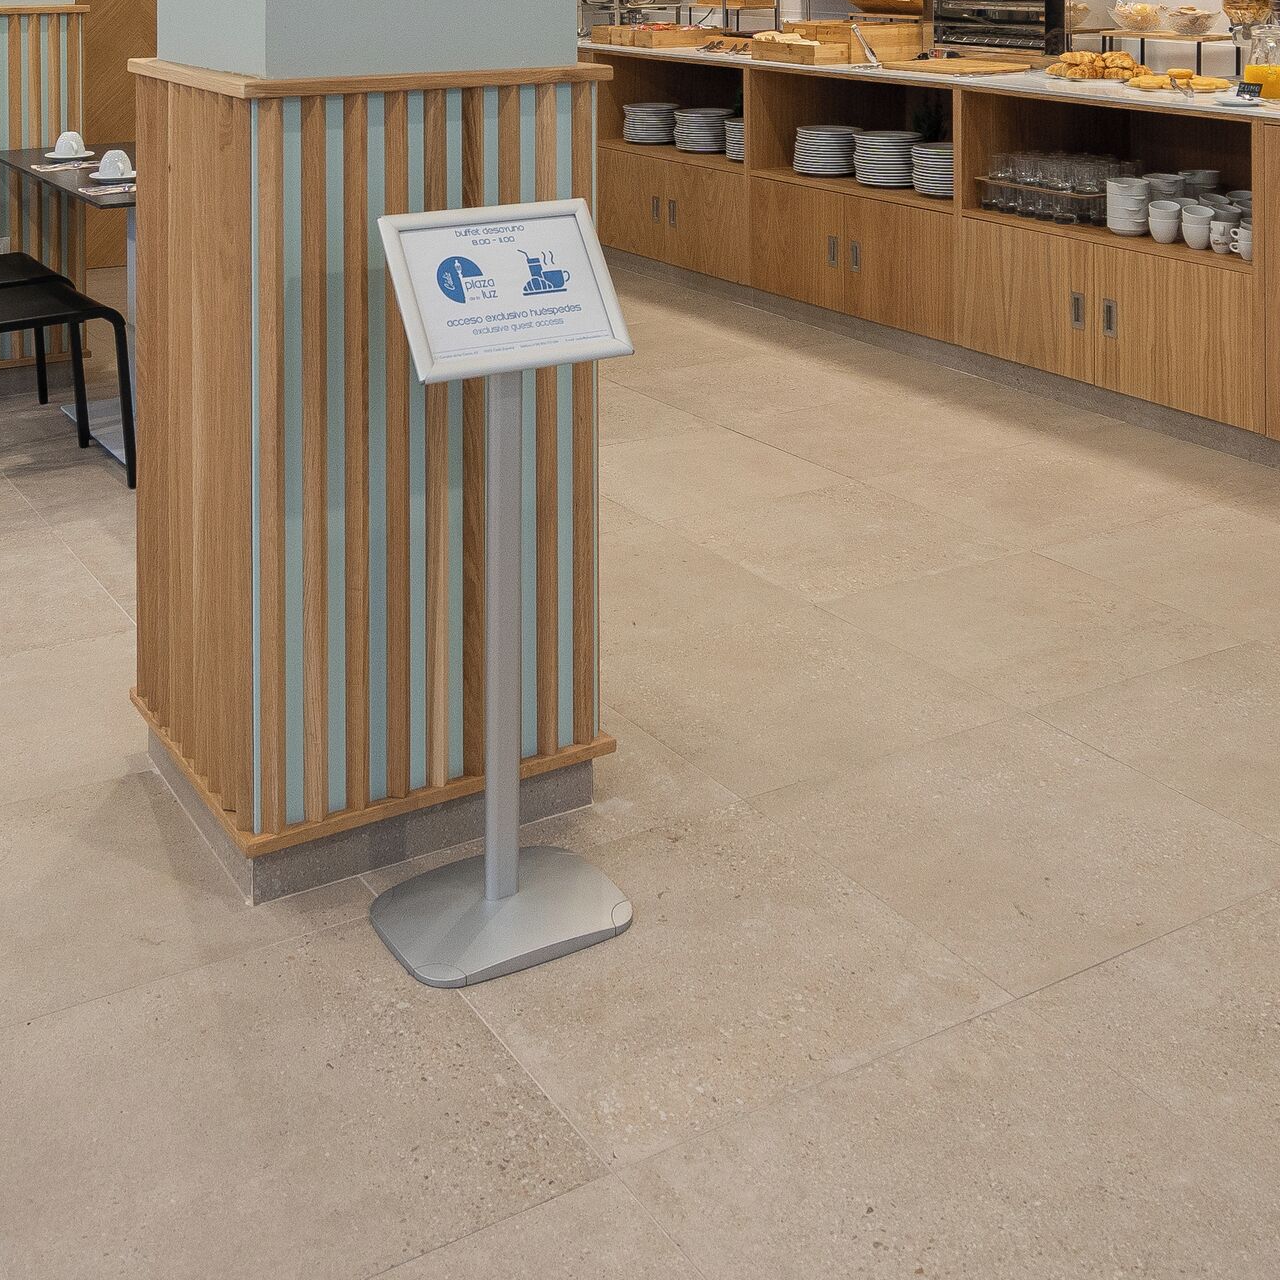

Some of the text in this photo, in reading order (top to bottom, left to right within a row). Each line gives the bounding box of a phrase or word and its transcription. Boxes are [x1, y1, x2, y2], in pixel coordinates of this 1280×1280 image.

[1239, 84, 1261, 92] ZUMO
[455, 224, 525, 238] buffet desayuno
[464, 278, 495, 292] plaza
[481, 289, 498, 300] luz
[446, 315, 483, 327] acceso
[485, 309, 528, 322] exclusivo
[472, 317, 565, 336] exclusive guest access
